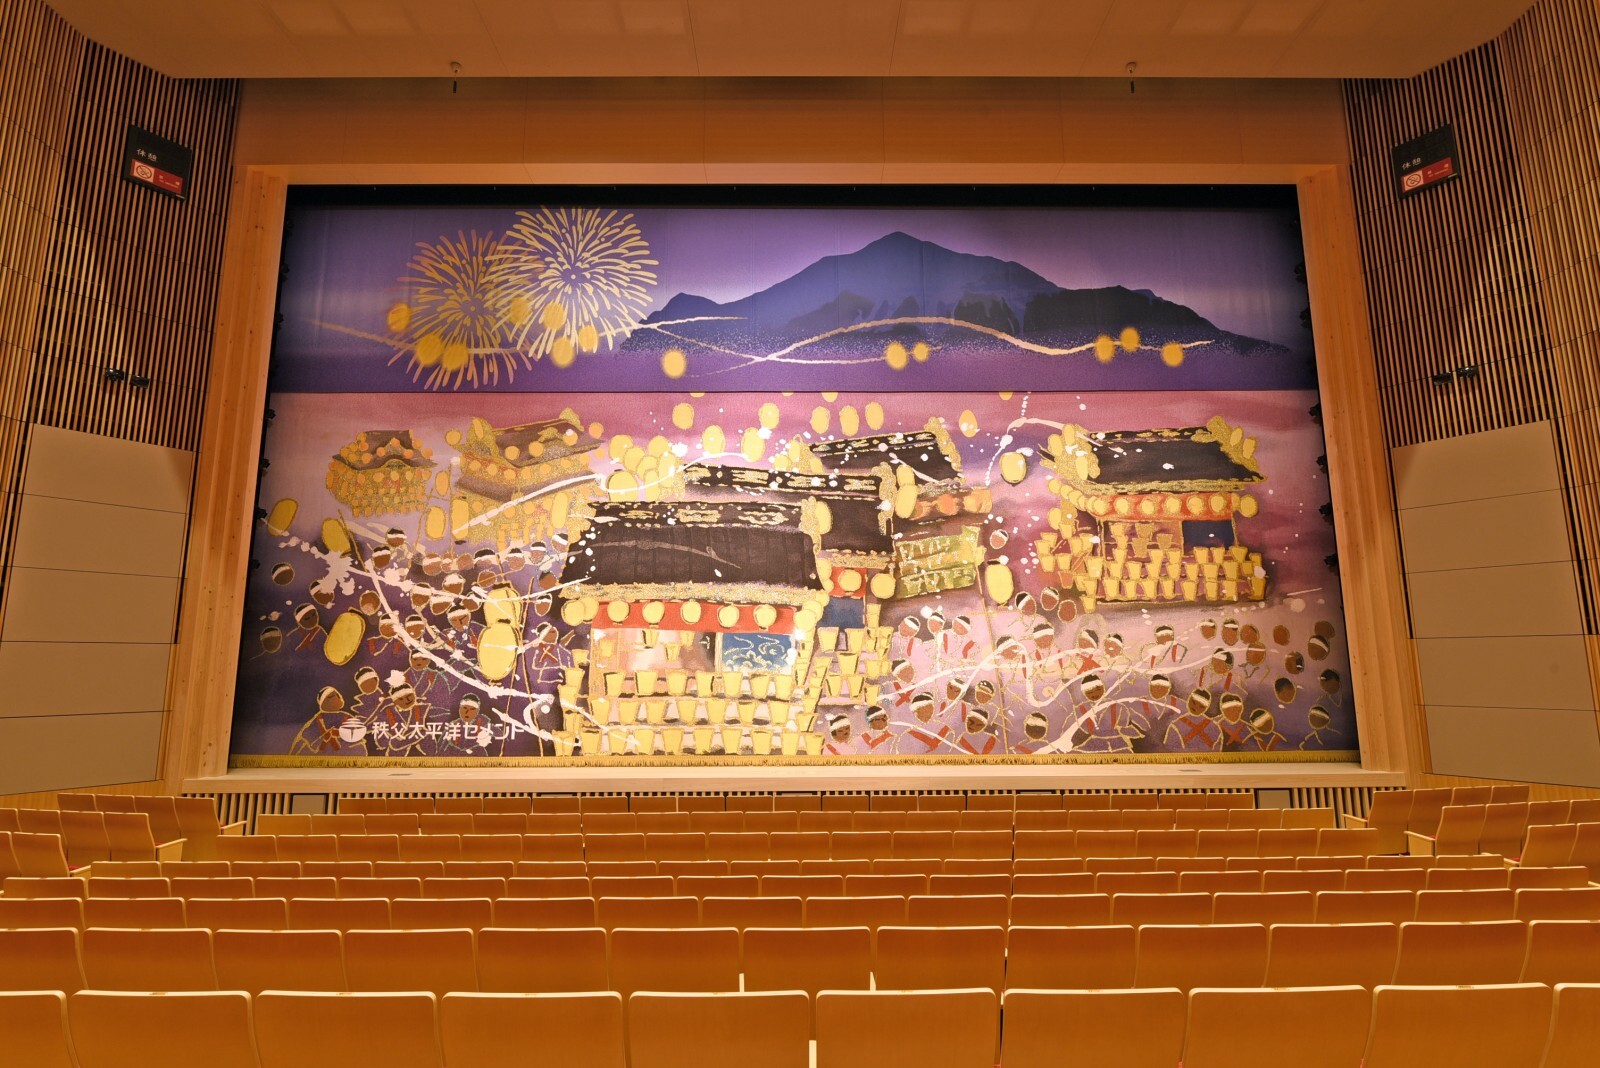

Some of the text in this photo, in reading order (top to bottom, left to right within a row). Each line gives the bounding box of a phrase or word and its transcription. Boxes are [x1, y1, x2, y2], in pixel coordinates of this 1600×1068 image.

[372, 721, 525, 740] 秩父太平洋セメント
